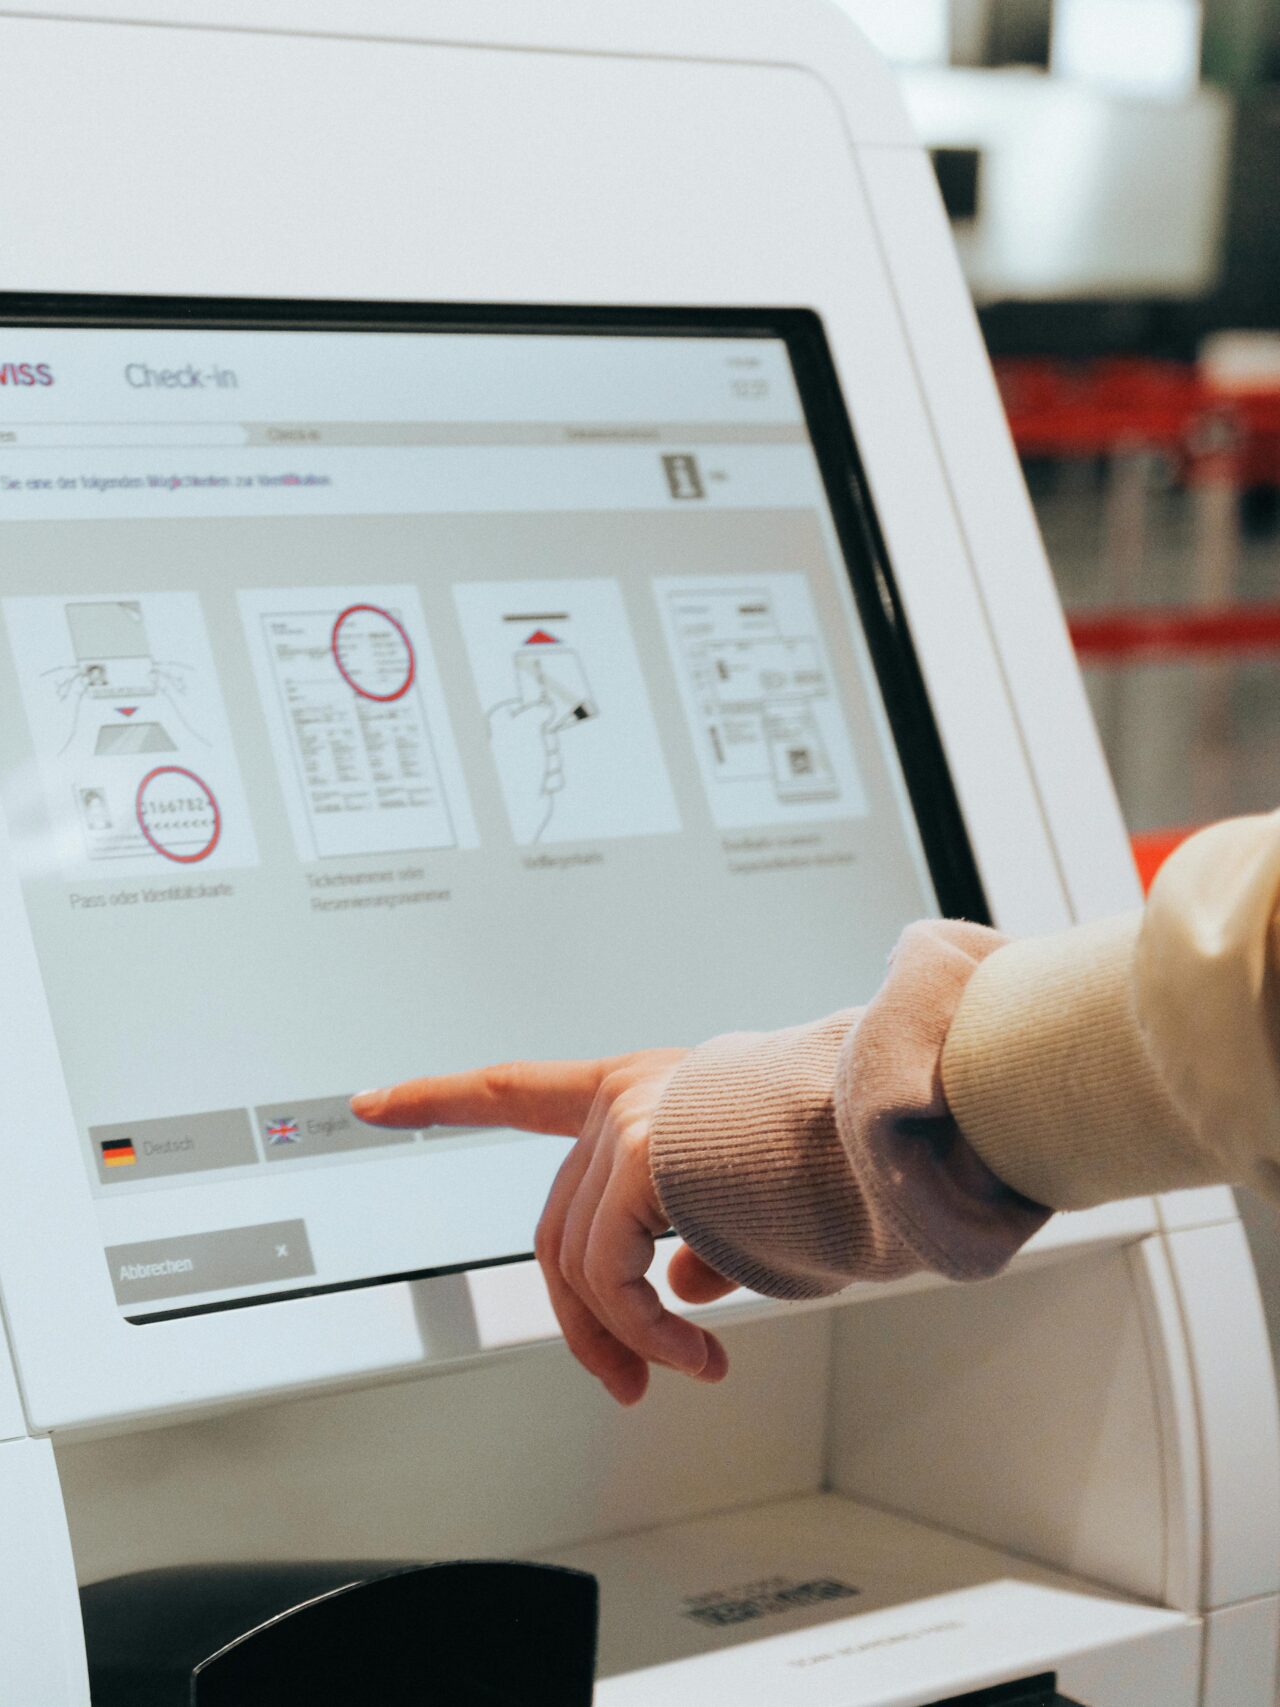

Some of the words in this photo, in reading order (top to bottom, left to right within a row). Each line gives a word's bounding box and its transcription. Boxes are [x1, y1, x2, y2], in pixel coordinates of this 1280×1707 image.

[124, 362, 238, 389] Check-in
[69, 892, 107, 909] Pass
[108, 889, 139, 907] oder
[141, 1136, 195, 1157] Deutsch
[120, 1257, 194, 1282] Abbrechen
